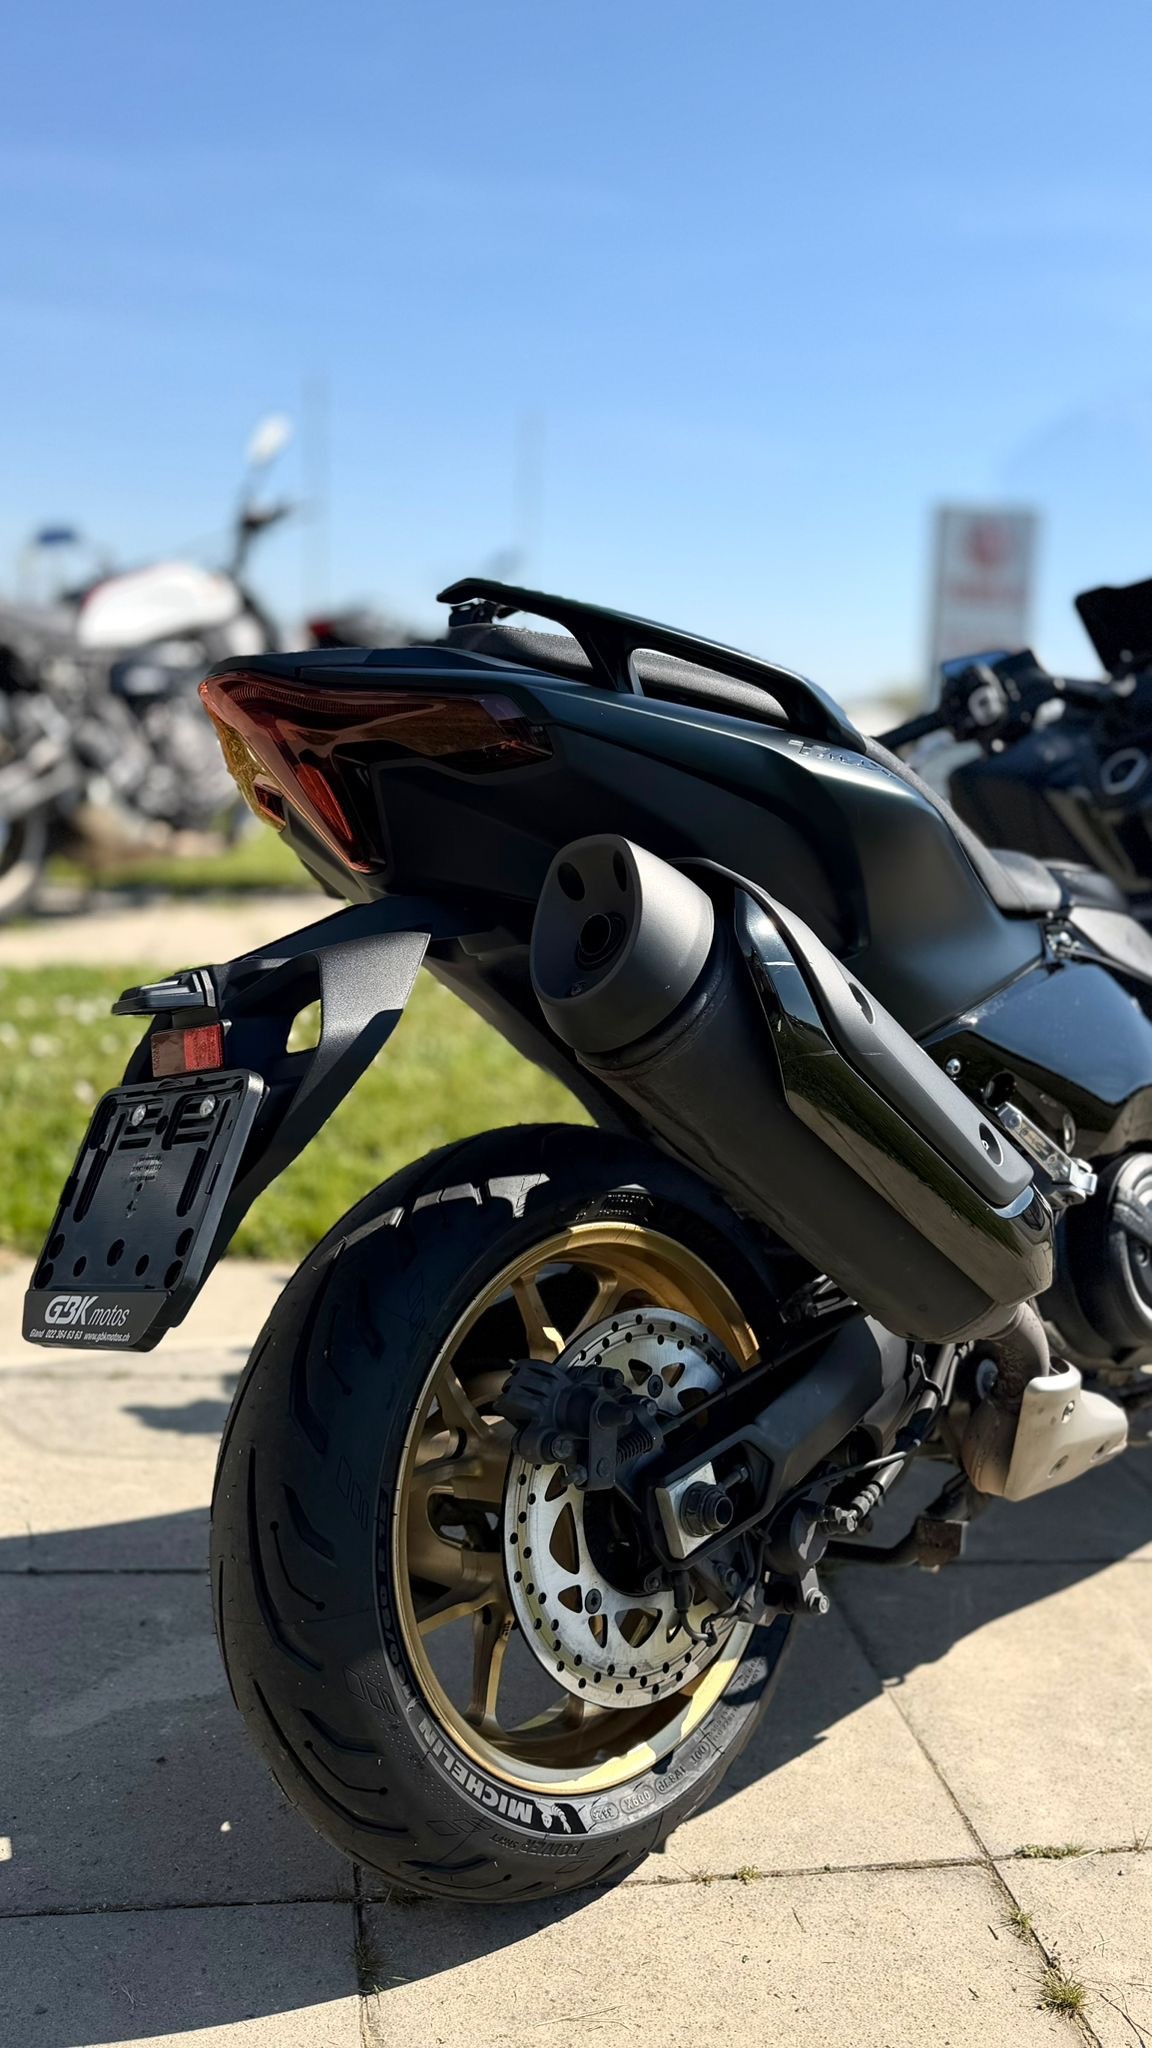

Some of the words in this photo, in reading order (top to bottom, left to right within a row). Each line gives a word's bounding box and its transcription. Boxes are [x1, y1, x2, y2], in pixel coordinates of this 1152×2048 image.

[44, 1295, 99, 1325] GBK
[87, 1304, 130, 1327] motos
[45, 1329, 57, 1338] 022
[56, 1330, 68, 1339] 364
[66, 1330, 75, 1339] 63
[74, 1330, 83, 1340] 63
[84, 1331, 130, 1342] www.gbkmotos.ch
[418, 1718, 534, 1824] MICHELIN
[519, 1838, 585, 1857] POWER
